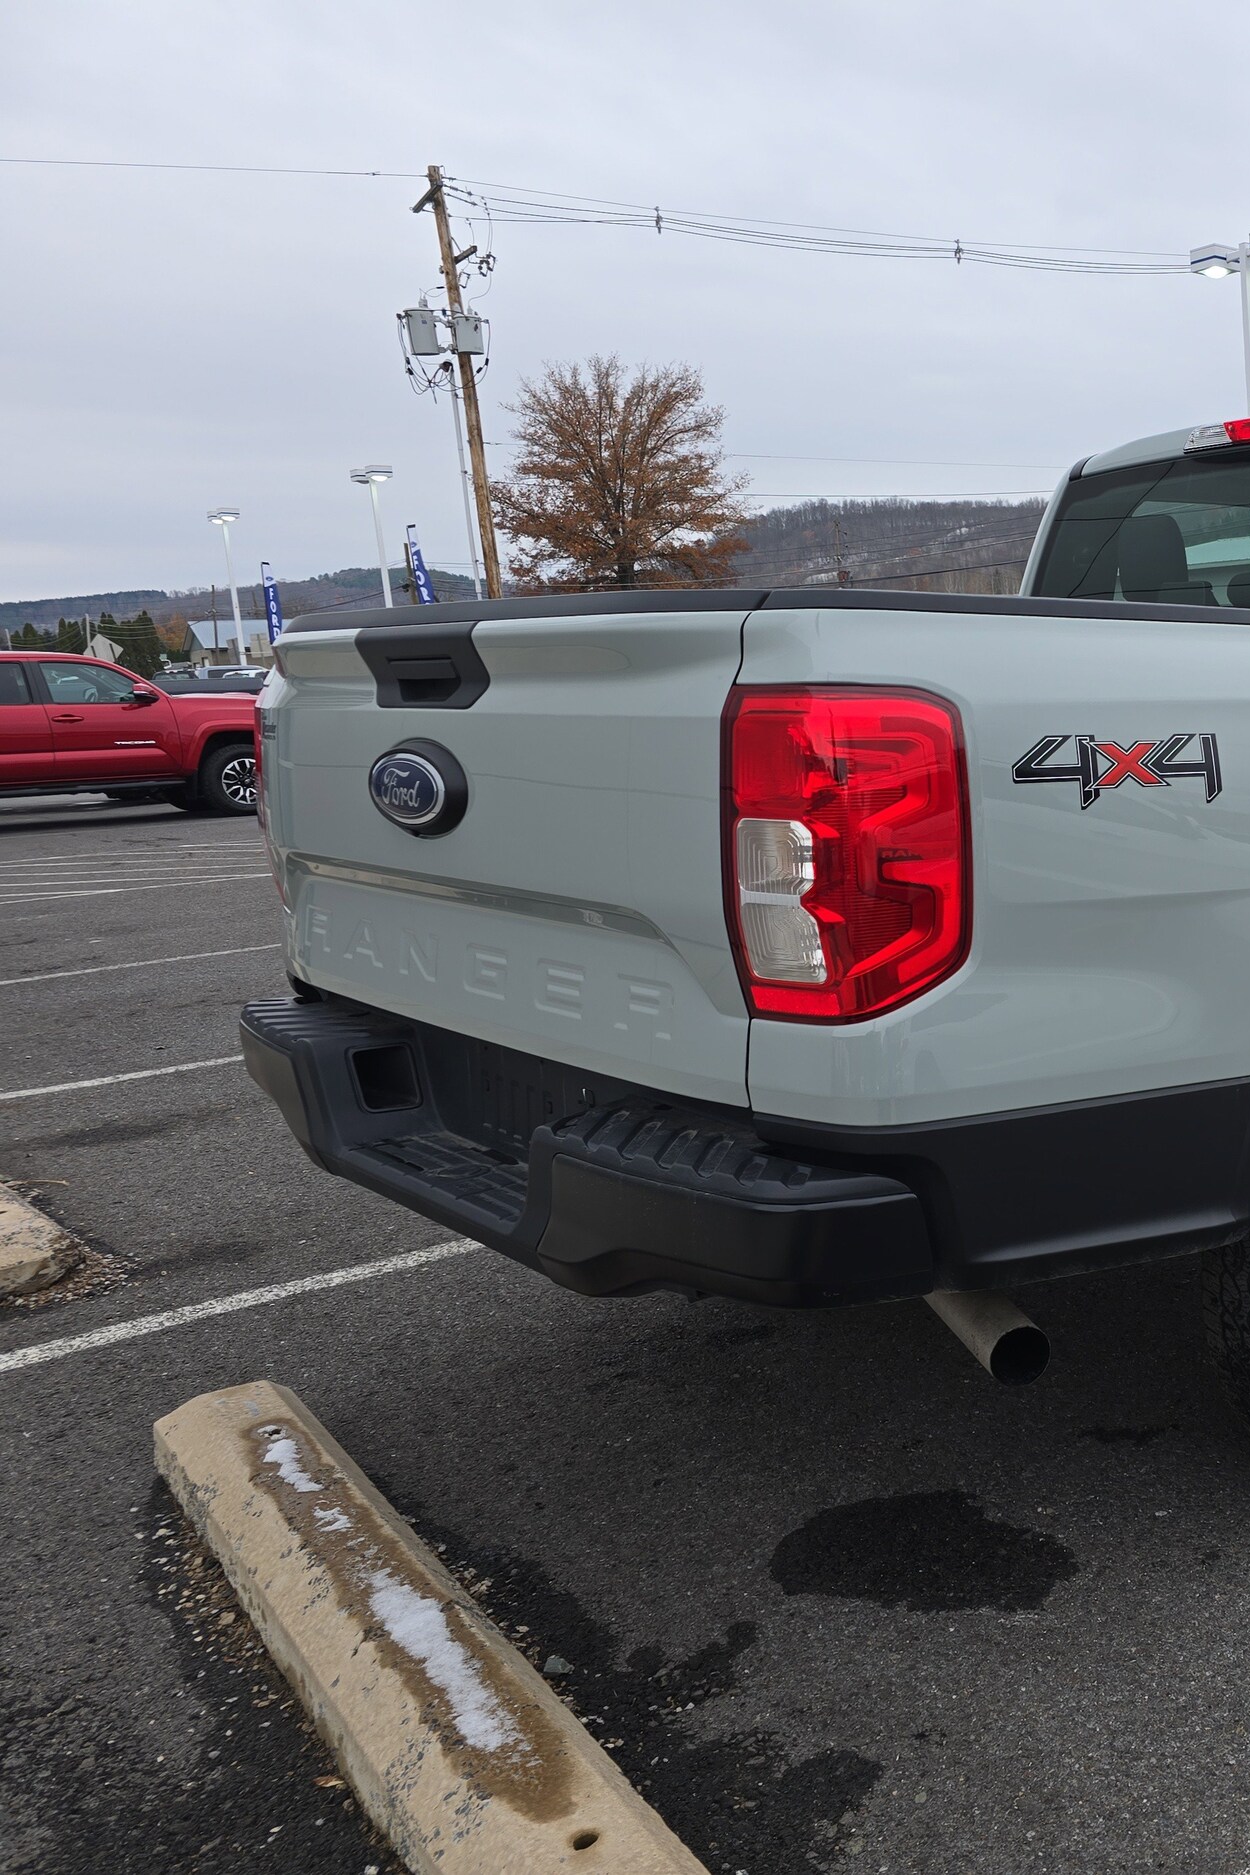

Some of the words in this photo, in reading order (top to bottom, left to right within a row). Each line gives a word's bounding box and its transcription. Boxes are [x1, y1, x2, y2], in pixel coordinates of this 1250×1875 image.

[412, 555, 432, 605] FOR
[268, 588, 282, 639] FORD
[381, 767, 421, 809] Ford
[303, 905, 675, 1041] RANGER
